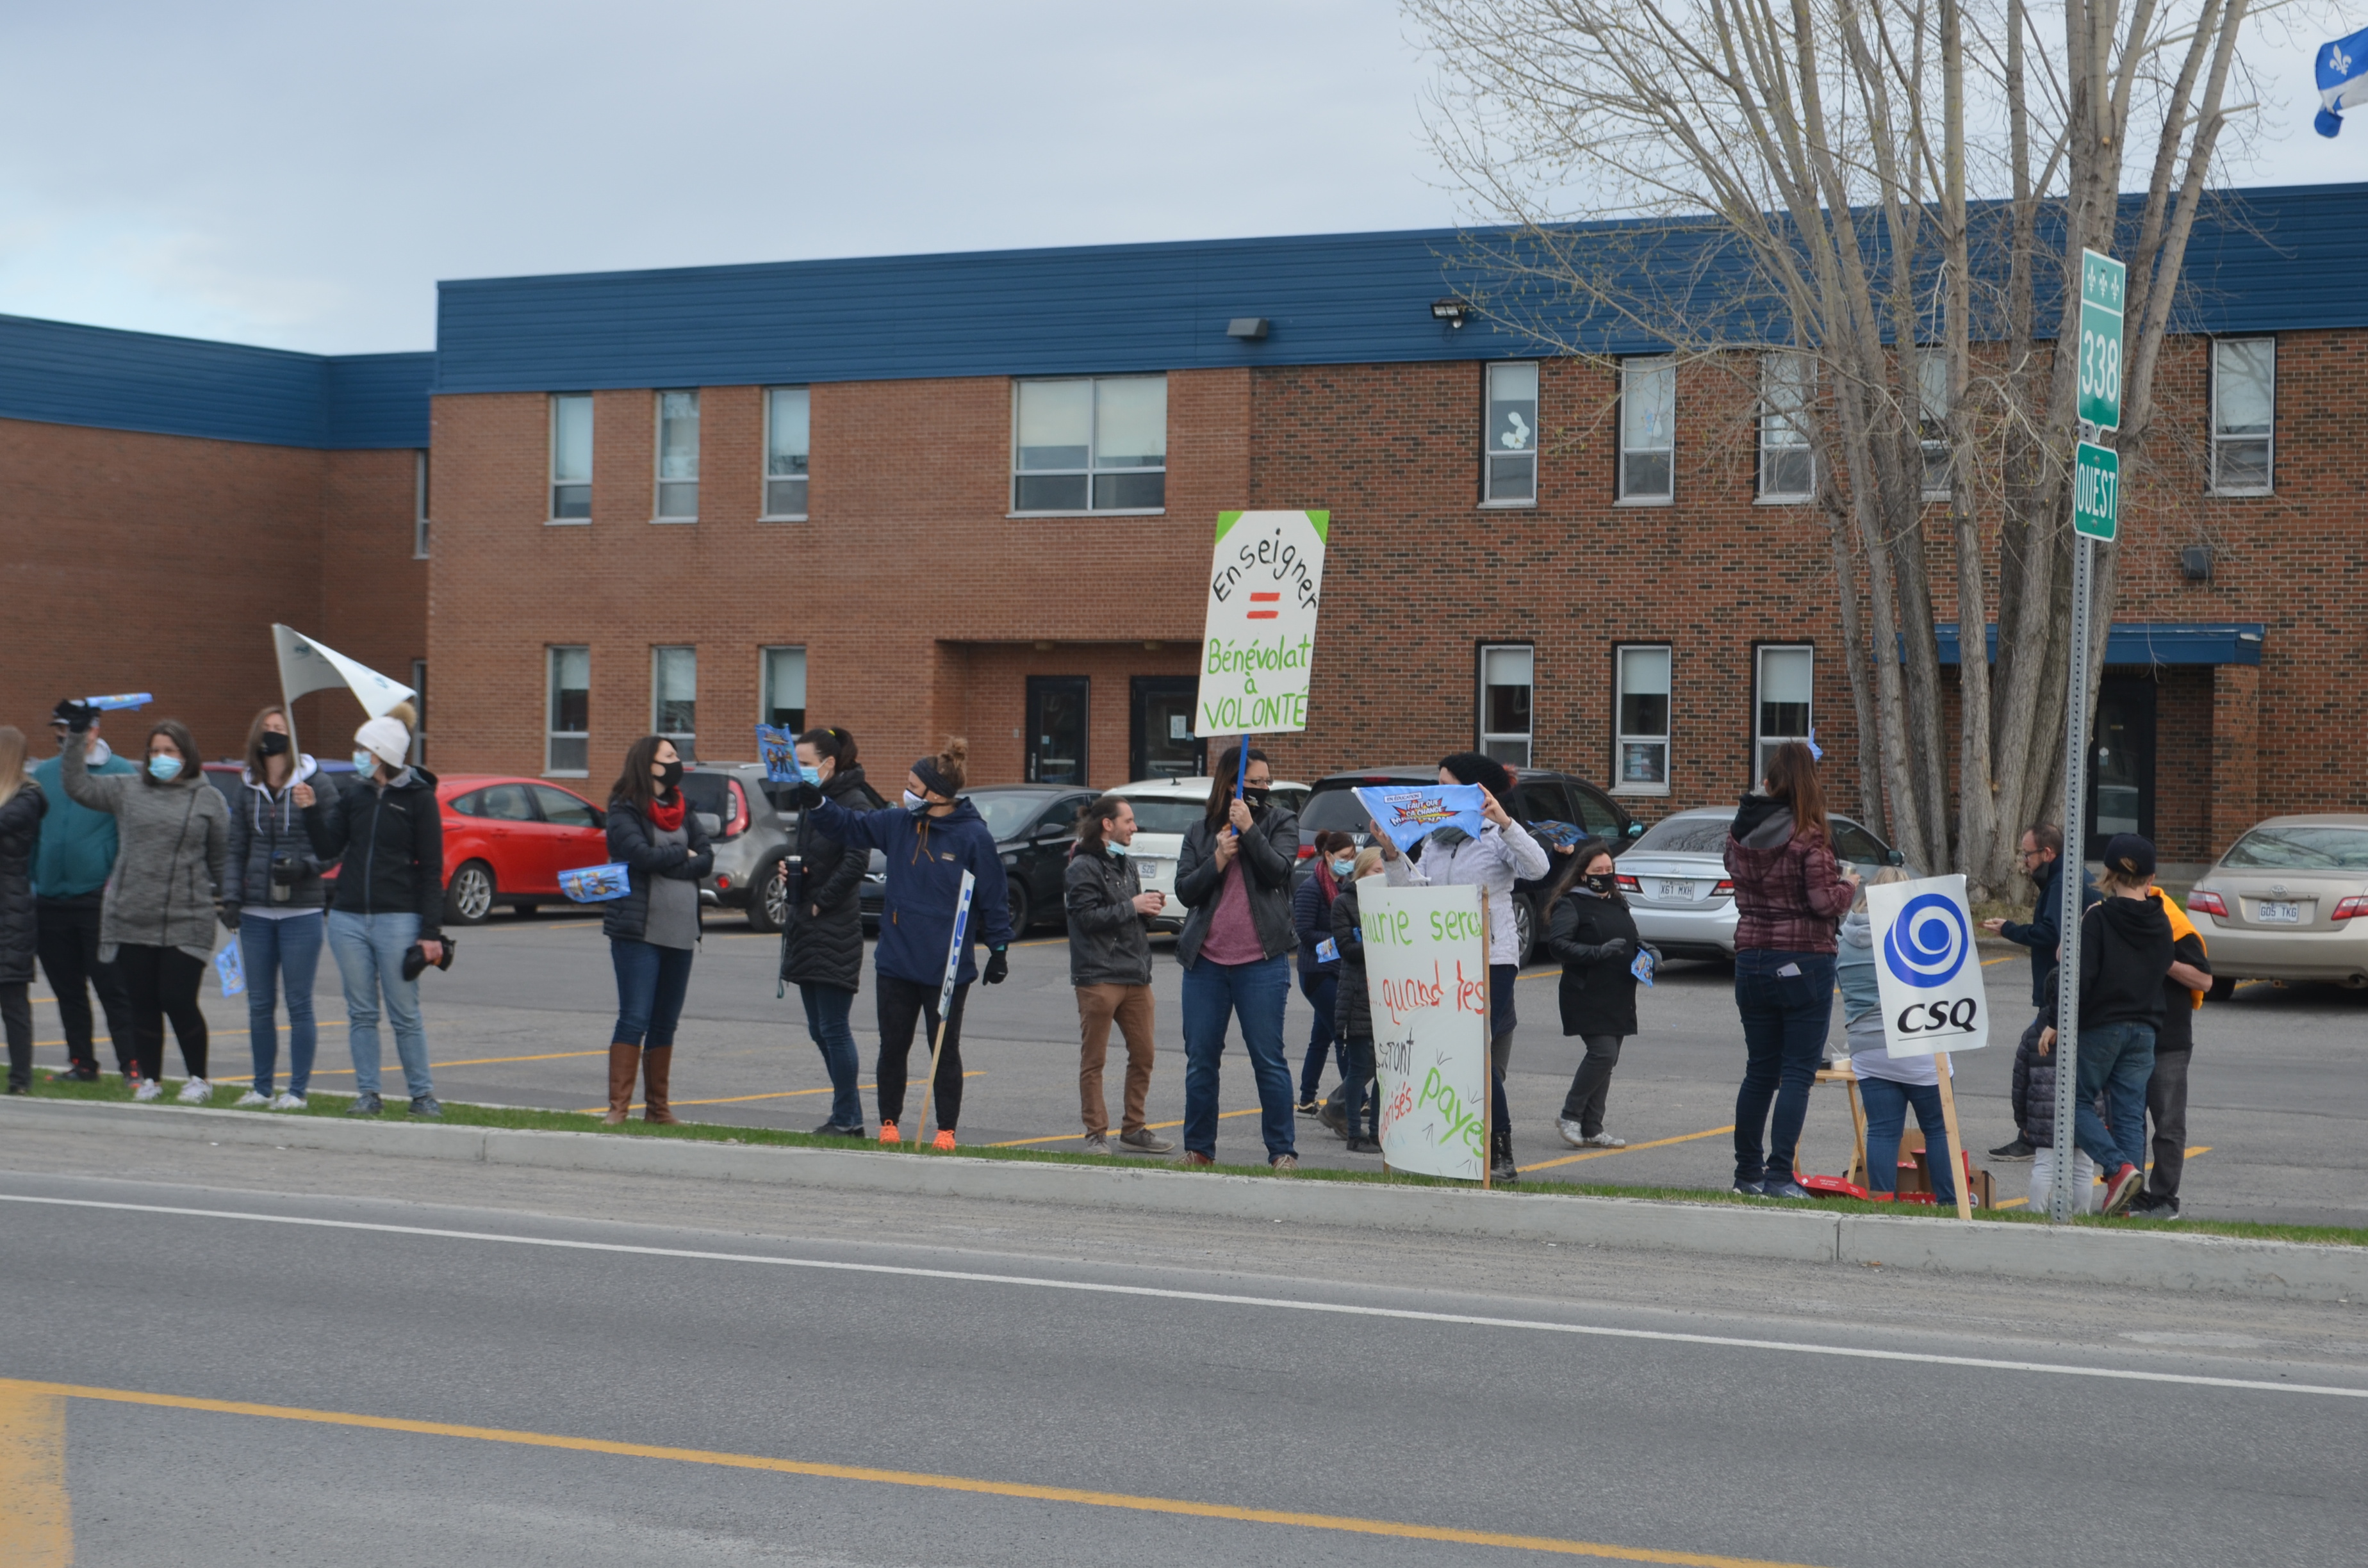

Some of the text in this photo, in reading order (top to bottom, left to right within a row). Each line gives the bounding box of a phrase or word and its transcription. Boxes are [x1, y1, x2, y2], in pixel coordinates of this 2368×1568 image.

[2082, 329, 2119, 402] 338
[2077, 462, 2116, 520] OUEST
[1213, 528, 1319, 609] Enseigner
[1208, 633, 1312, 674] Bénévolat
[1244, 671, 1258, 695] à
[1204, 685, 1309, 730] VOLONTÉ
[1407, 799, 1439, 810] FAUT QUE
[1417, 806, 1443, 816] CHANGE
[1661, 885, 1692, 896] X61 MXH
[1430, 910, 1483, 942] sera
[2282, 907, 2297, 918] TKG
[1897, 997, 1978, 1033] CSQ
